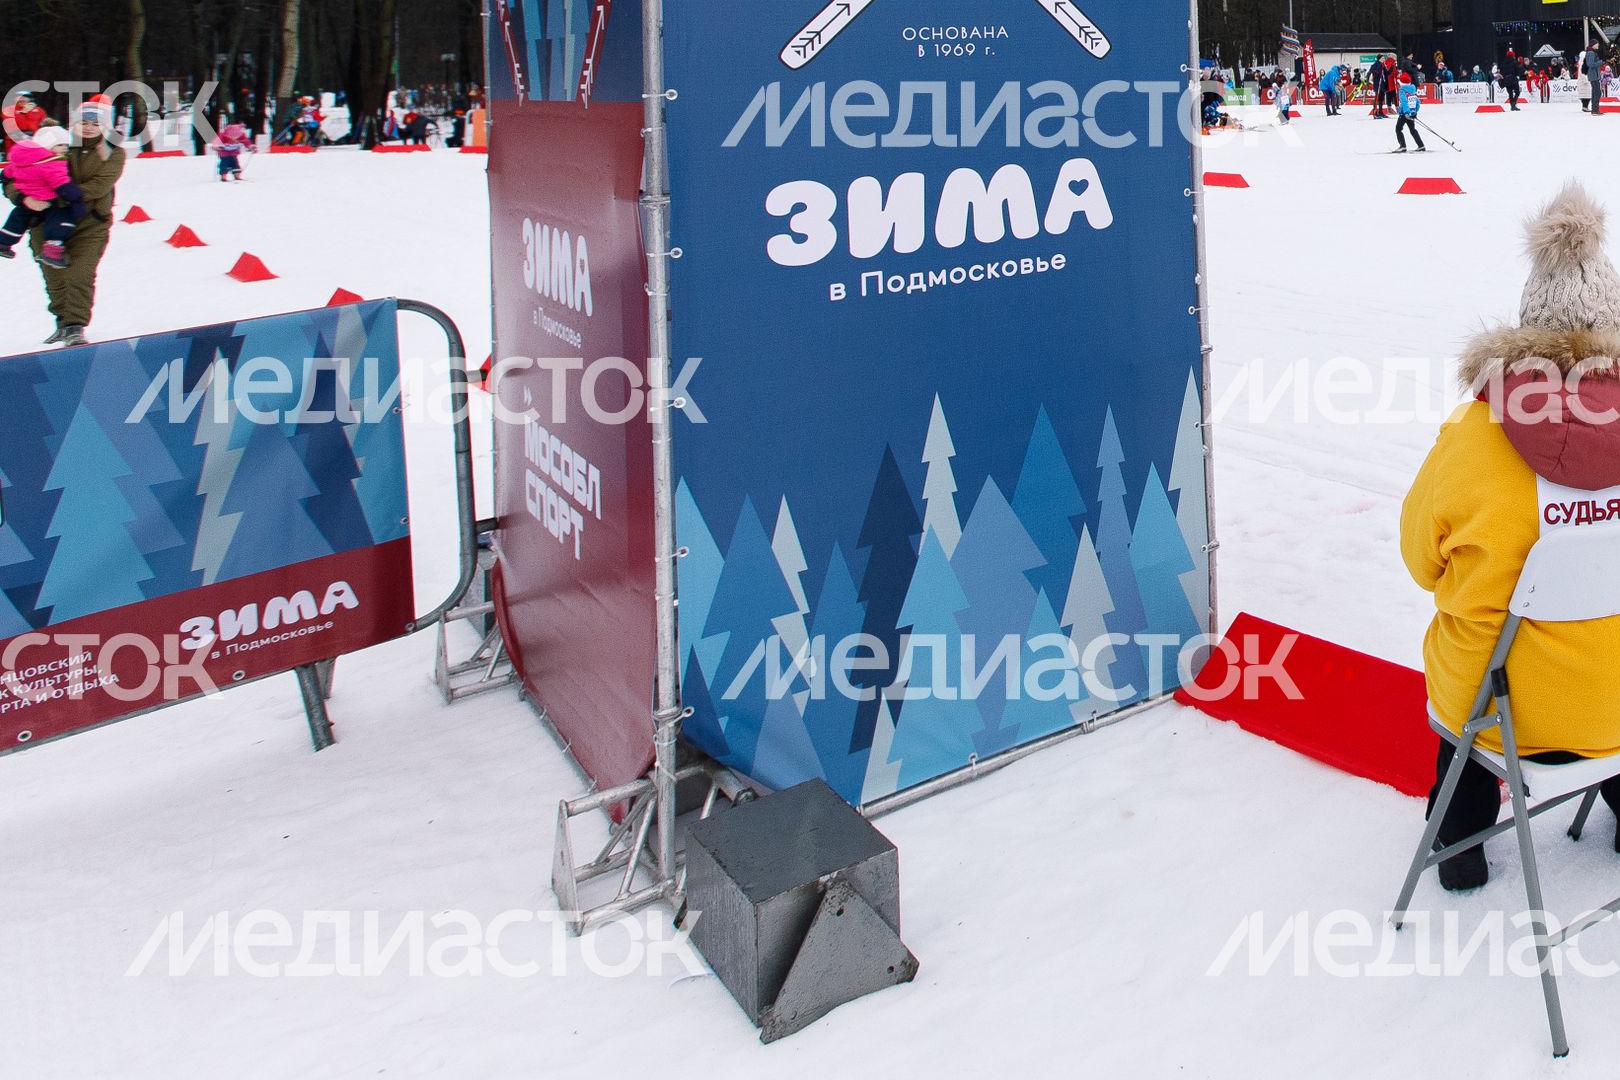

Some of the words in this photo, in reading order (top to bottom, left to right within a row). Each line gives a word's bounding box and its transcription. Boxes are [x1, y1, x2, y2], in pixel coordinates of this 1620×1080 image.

[901, 24, 1010, 42] ОСНОВАНА
[933, 42, 977, 58] 1969
[1454, 84, 1470, 94] devi
[1562, 82, 1578, 92] dev
[764, 157, 1114, 267] ЗИМА
[522, 217, 593, 316] ЗИМА
[828, 282, 847, 302] в
[860, 252, 1068, 298] Подмосковье
[524, 414, 601, 521] МОСОБЛ
[524, 467, 584, 561] СПОРТ
[179, 580, 360, 651] ЗИМА
[210, 649, 221, 660] в
[226, 619, 334, 656] Подмосковье
[0, 650, 93, 685] НЦОВСКИЙ
[0, 697, 32, 714] РТА
[35, 692, 48, 704] И
[51, 673, 120, 699] ОТДЫХА
